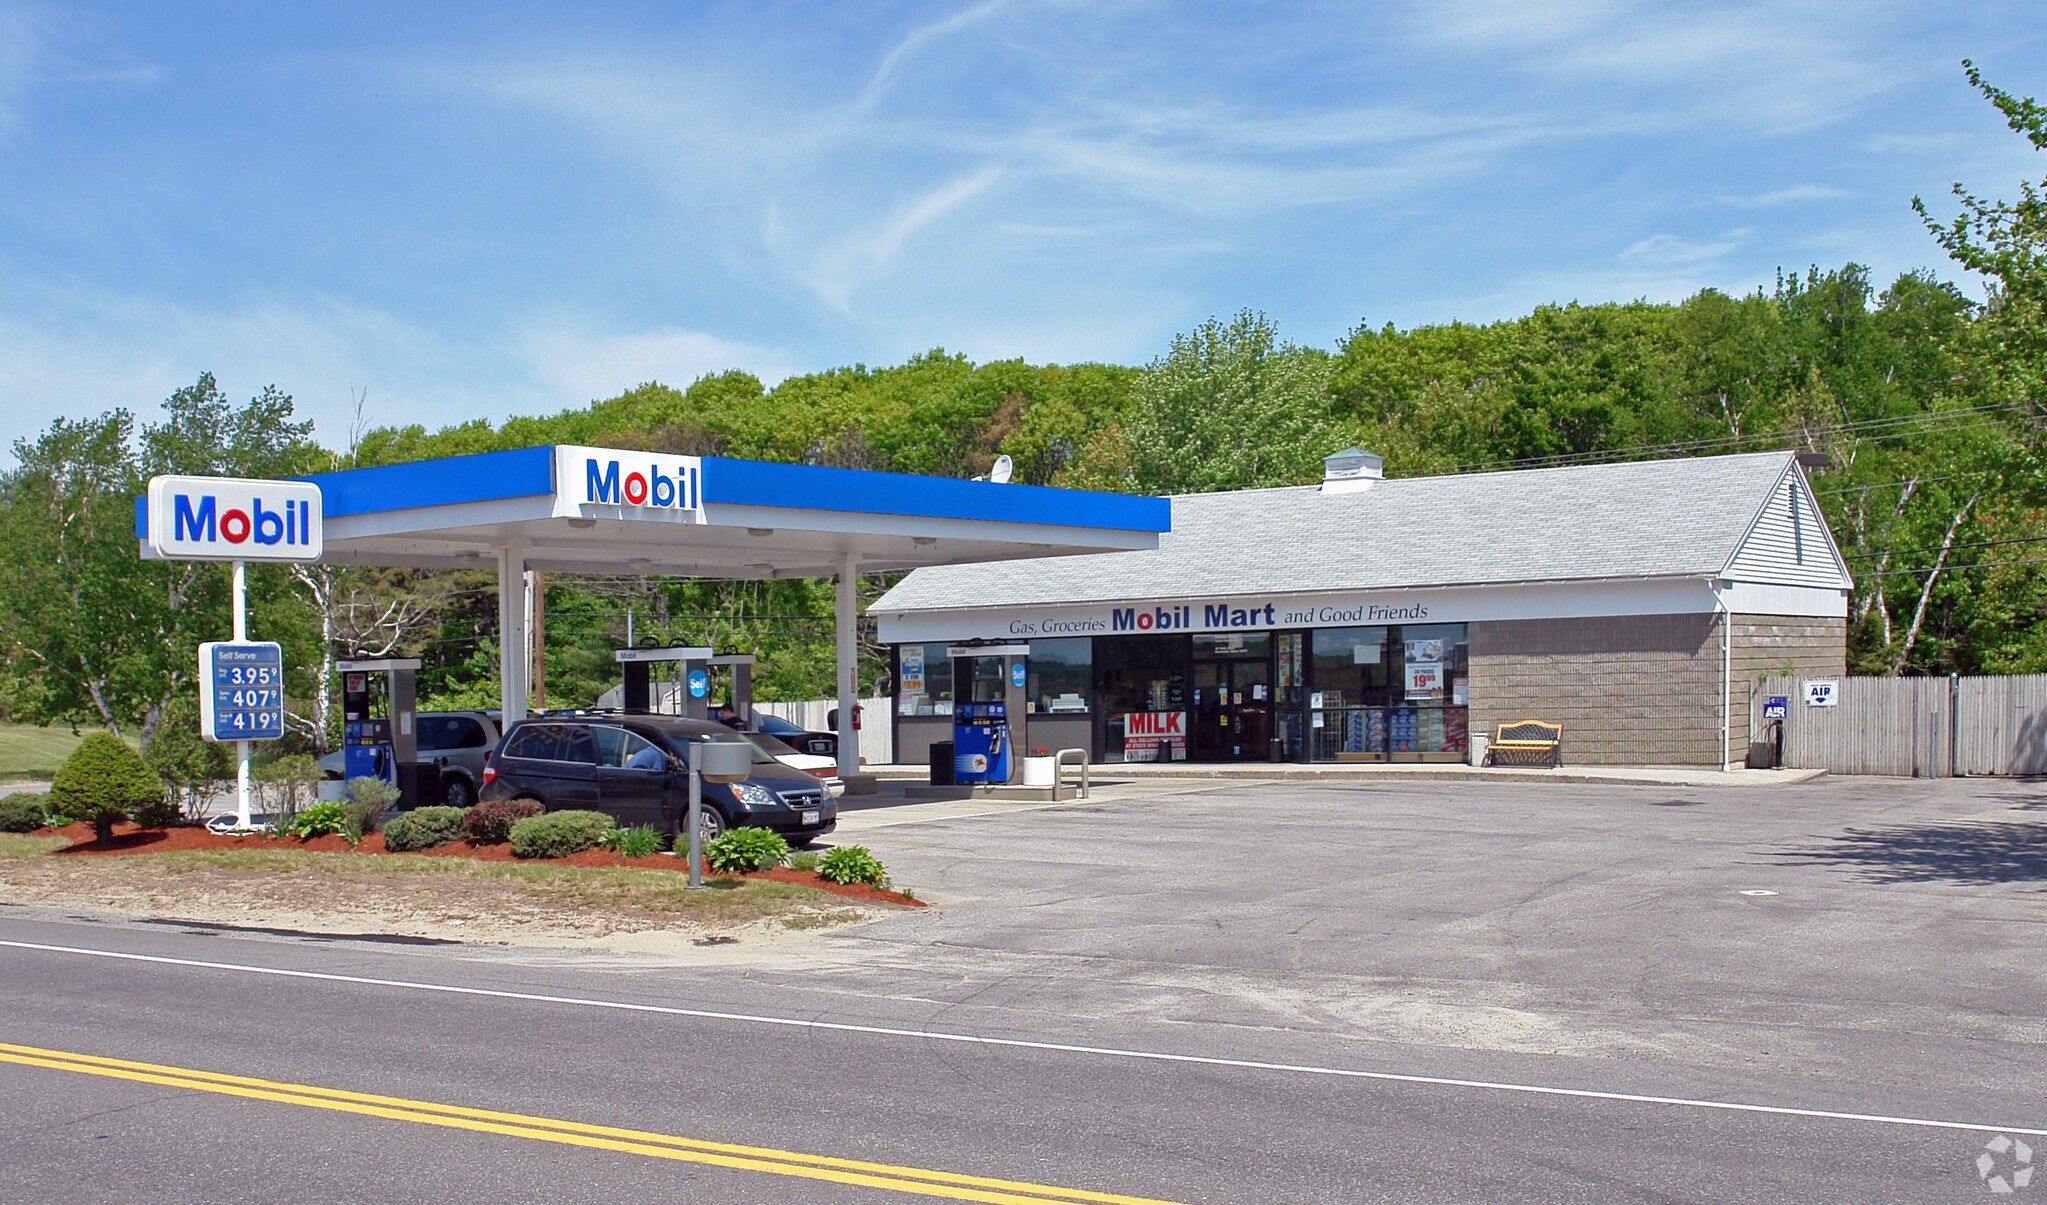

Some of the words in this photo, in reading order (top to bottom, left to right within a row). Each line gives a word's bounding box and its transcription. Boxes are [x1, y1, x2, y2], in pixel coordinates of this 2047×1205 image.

[586, 458, 698, 509] Mobil
[174, 493, 309, 546] Mobil
[1009, 619, 1038, 635] Gas,
[1041, 617, 1106, 633] Groceries
[1112, 605, 1190, 631] Mobil
[1204, 602, 1275, 628] Mart
[1284, 608, 1315, 624] and
[1319, 606, 1363, 622] Good
[1367, 603, 1429, 620] Friends
[218, 651, 233, 660] Self
[233, 651, 256, 660] Serve
[620, 651, 637, 660] Mobil
[1013, 670, 1025, 680] Self
[689, 677, 707, 689] Self
[1811, 686, 1831, 696] AIR
[1765, 706, 1786, 718] AIR
[1129, 711, 1181, 734] MILK
